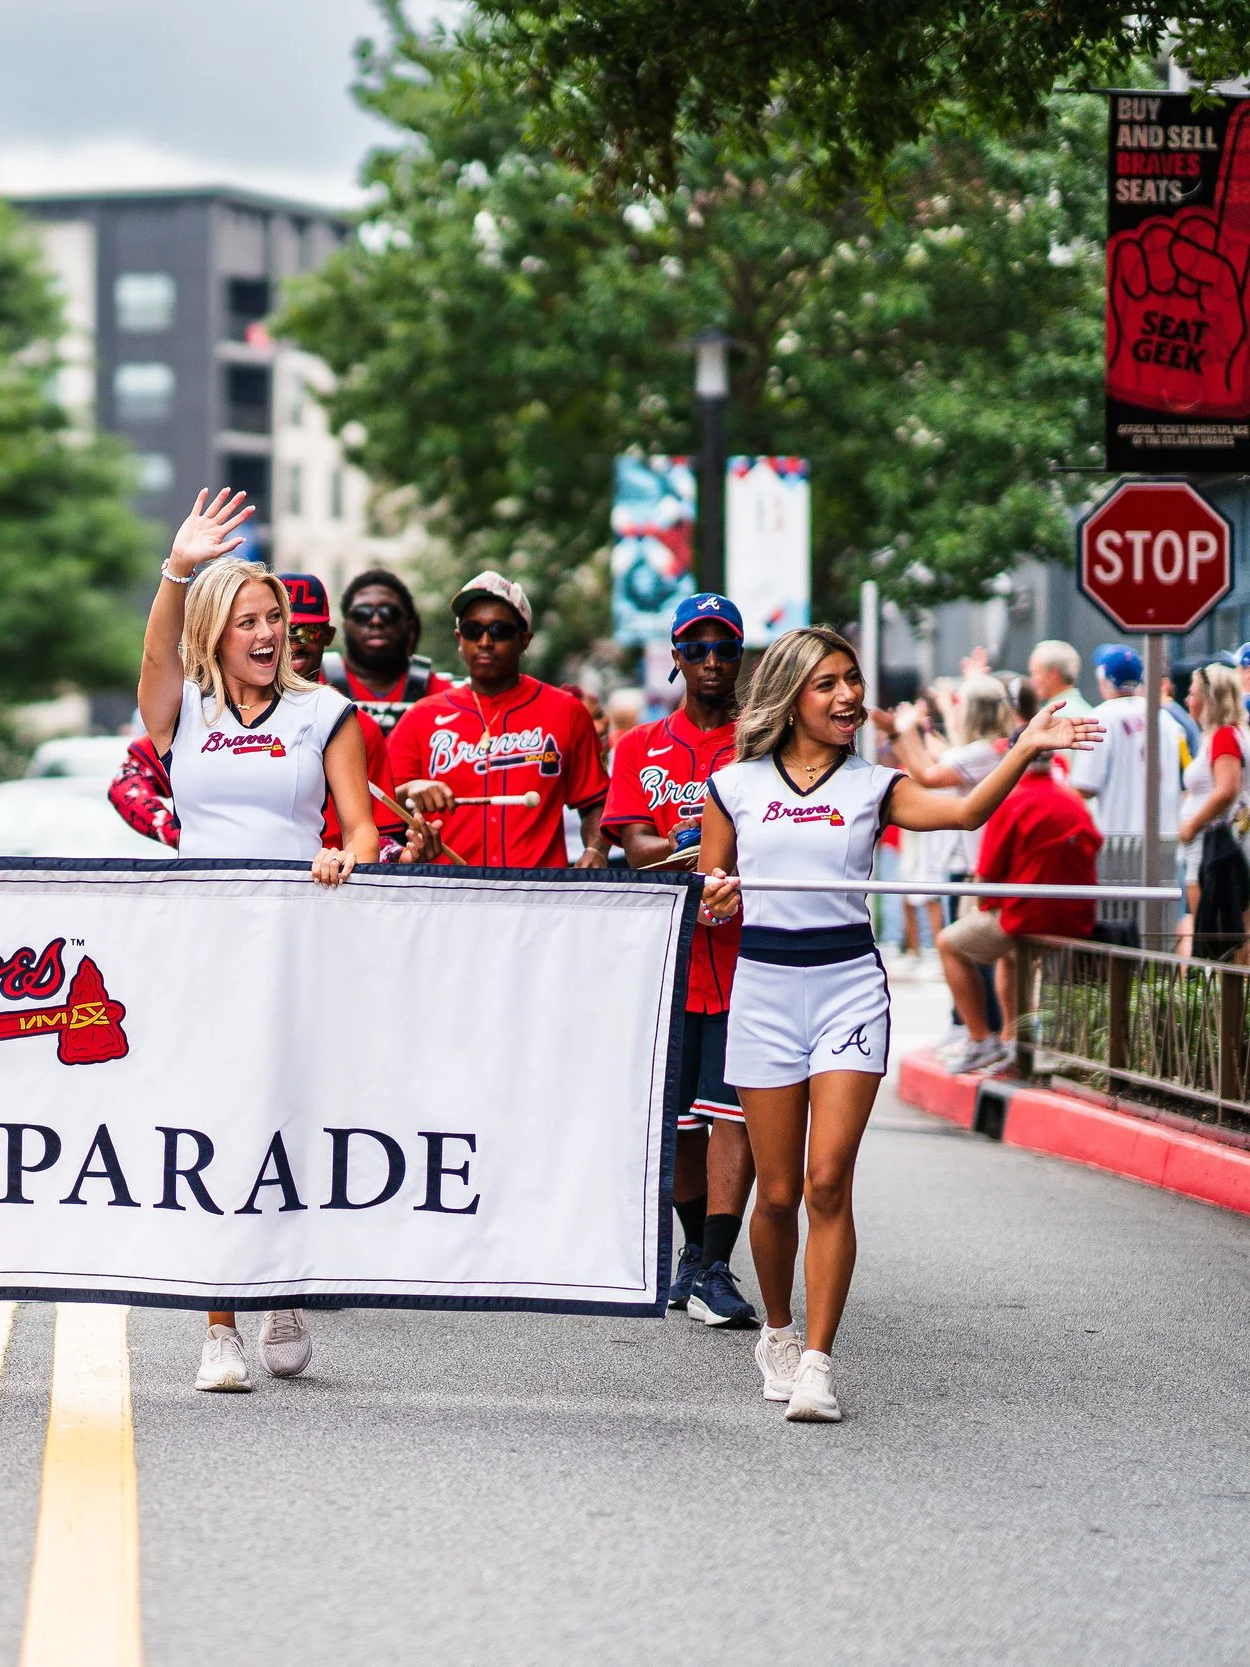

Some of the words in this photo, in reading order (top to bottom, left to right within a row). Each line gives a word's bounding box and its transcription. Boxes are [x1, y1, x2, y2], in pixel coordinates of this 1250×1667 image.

[1117, 97, 1161, 120] BUY
[1116, 124, 1164, 148] AND
[1167, 125, 1218, 149] SELL
[1116, 151, 1201, 175] BRAVES
[1115, 178, 1183, 203] SEATS
[1141, 310, 1210, 345] SEAT
[1132, 338, 1207, 375] GEEK
[1117, 424, 1155, 434] OFFICIAL
[1157, 424, 1185, 434] TICKET
[1133, 434, 1143, 444] OF
[1145, 434, 1159, 444] THE
[1201, 435, 1234, 445] BRAVES
[1093, 530, 1218, 586] STOP
[282, 579, 317, 605] TL
[201, 732, 272, 753] Braves
[429, 727, 543, 779] Braves
[762, 801, 831, 823] Braves
[831, 1022, 871, 1056] A
